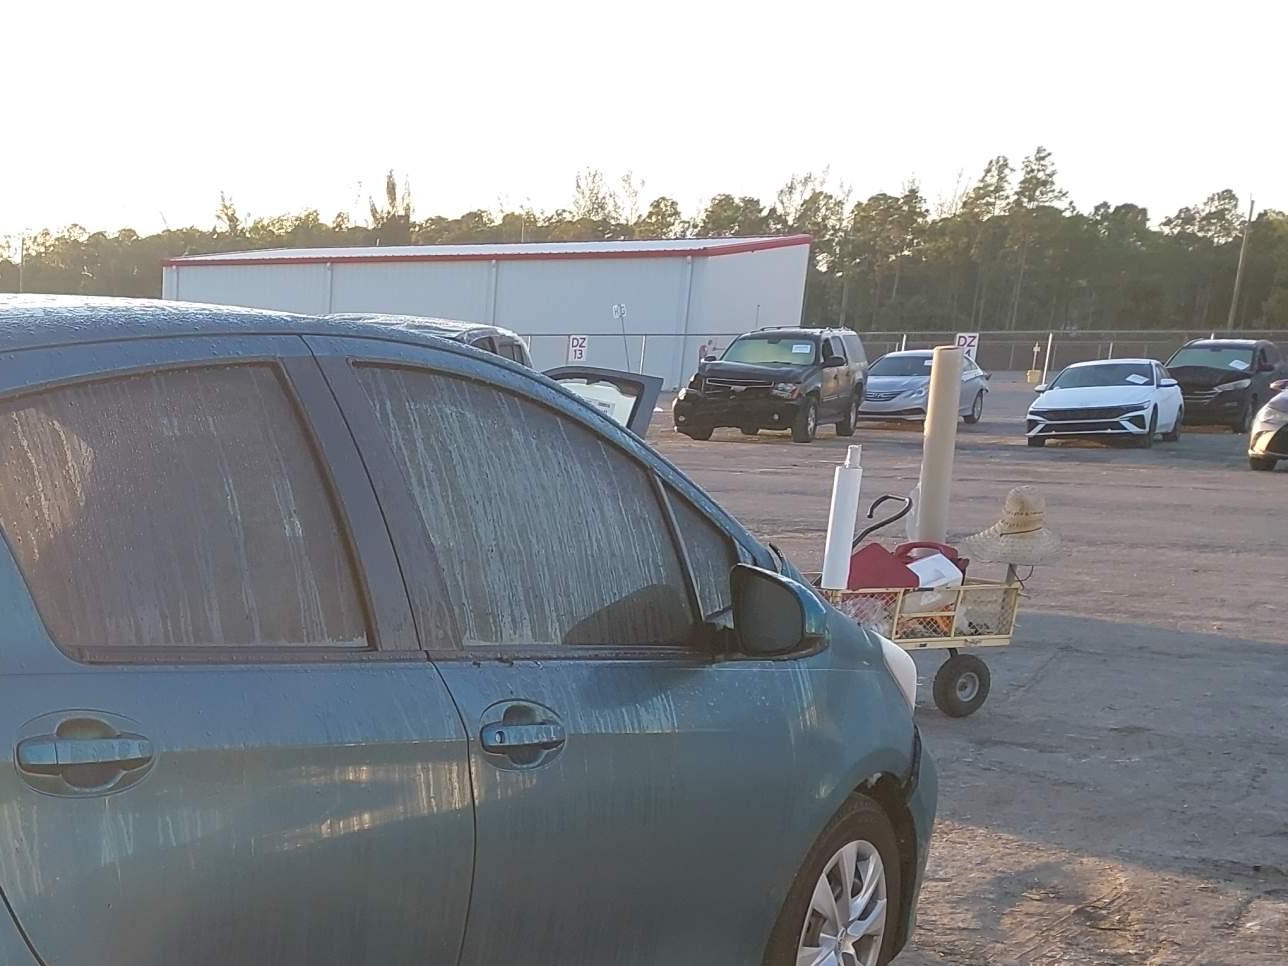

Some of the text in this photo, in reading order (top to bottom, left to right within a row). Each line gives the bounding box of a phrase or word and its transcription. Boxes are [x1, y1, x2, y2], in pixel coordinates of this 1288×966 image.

[572, 337, 586, 348] DZ
[957, 335, 977, 347] DZ
[573, 349, 583, 359] 13
